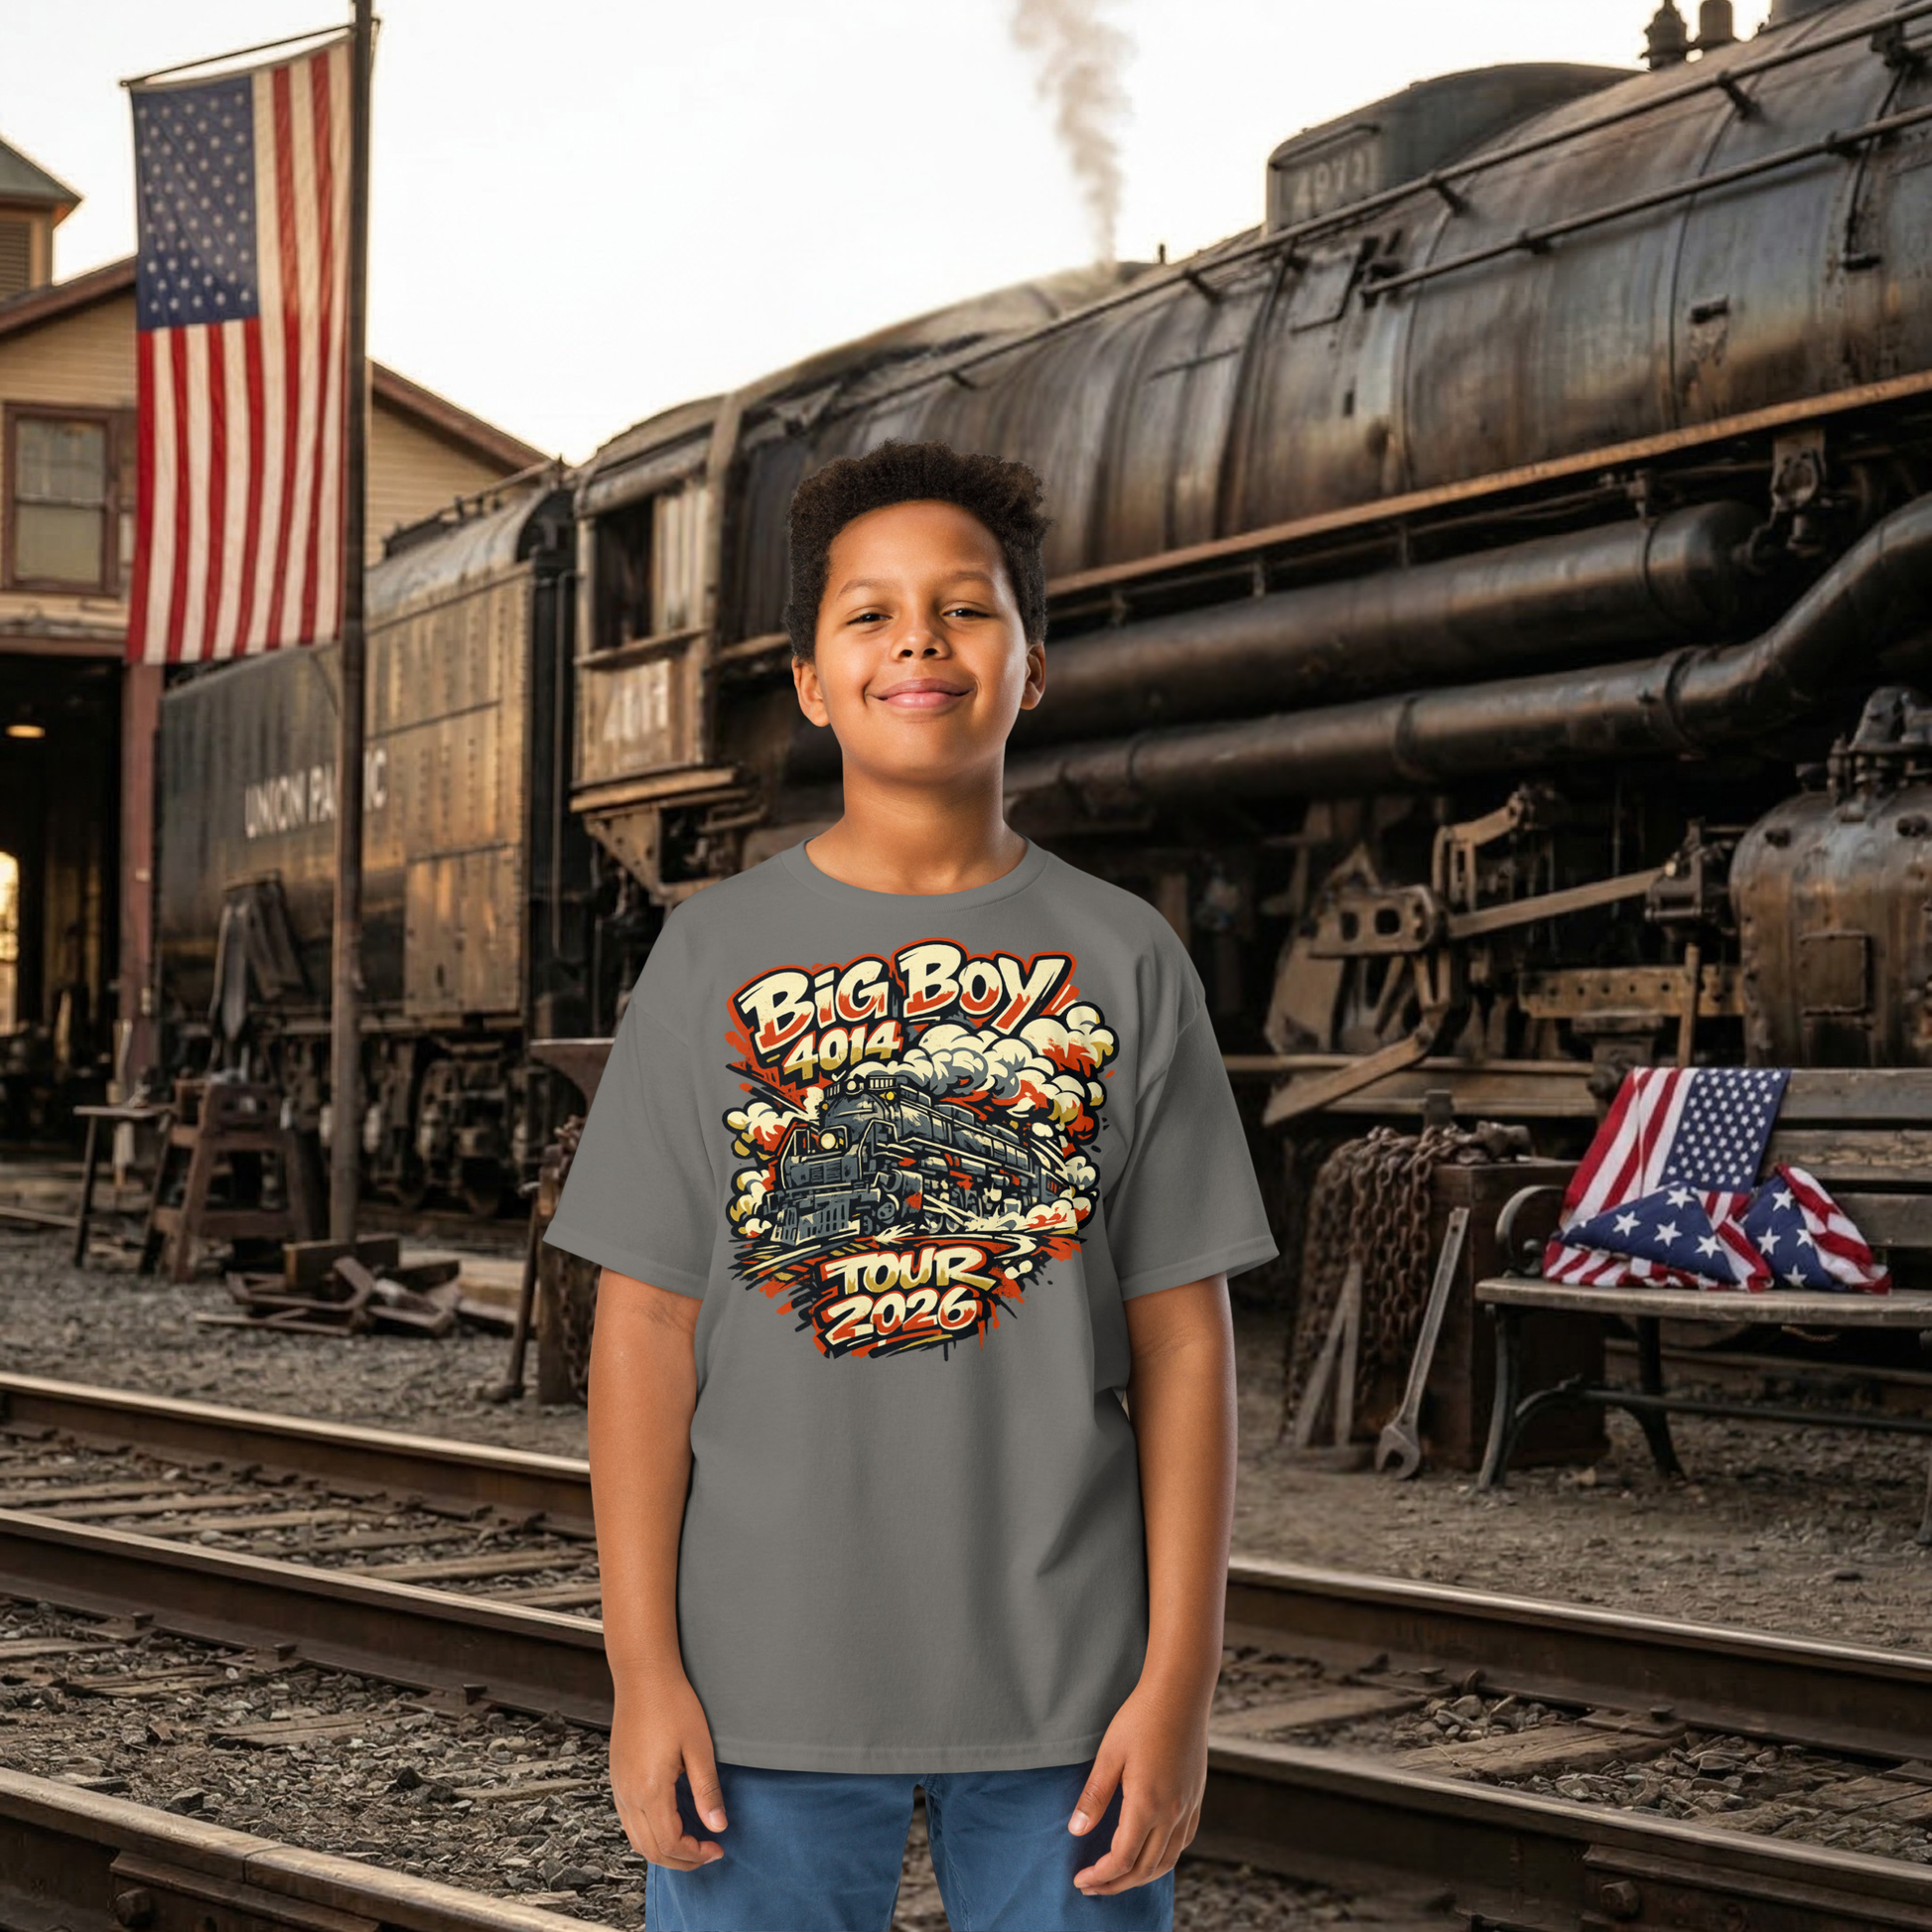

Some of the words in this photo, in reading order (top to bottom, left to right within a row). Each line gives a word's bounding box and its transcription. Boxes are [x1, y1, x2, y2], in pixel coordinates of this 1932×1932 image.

[897, 943, 1066, 1036] BOY
[782, 1020, 903, 1081] 4014
[823, 1246, 998, 1296] TOUR
[824, 1286, 979, 1346] 2026
